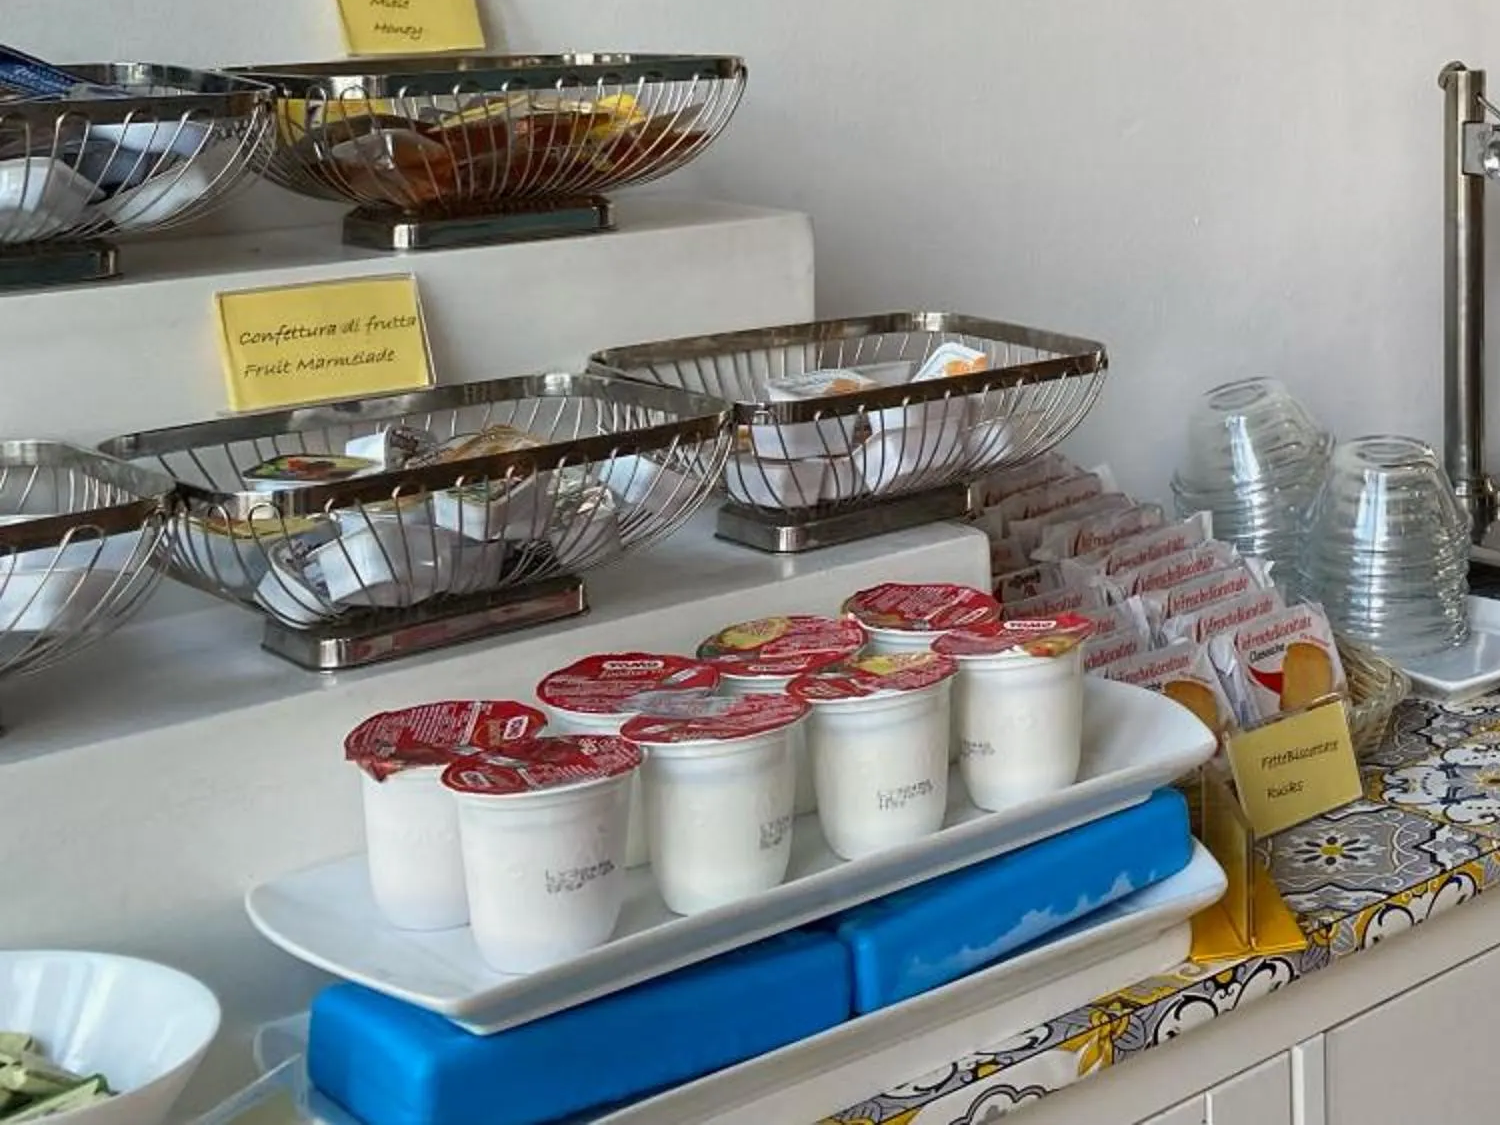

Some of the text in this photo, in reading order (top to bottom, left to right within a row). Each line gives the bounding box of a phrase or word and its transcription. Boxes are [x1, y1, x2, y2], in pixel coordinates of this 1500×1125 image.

[373, 21, 424, 41] Honey
[341, 315, 362, 336] di
[364, 312, 418, 336] frutta
[243, 359, 293, 380] Fruit
